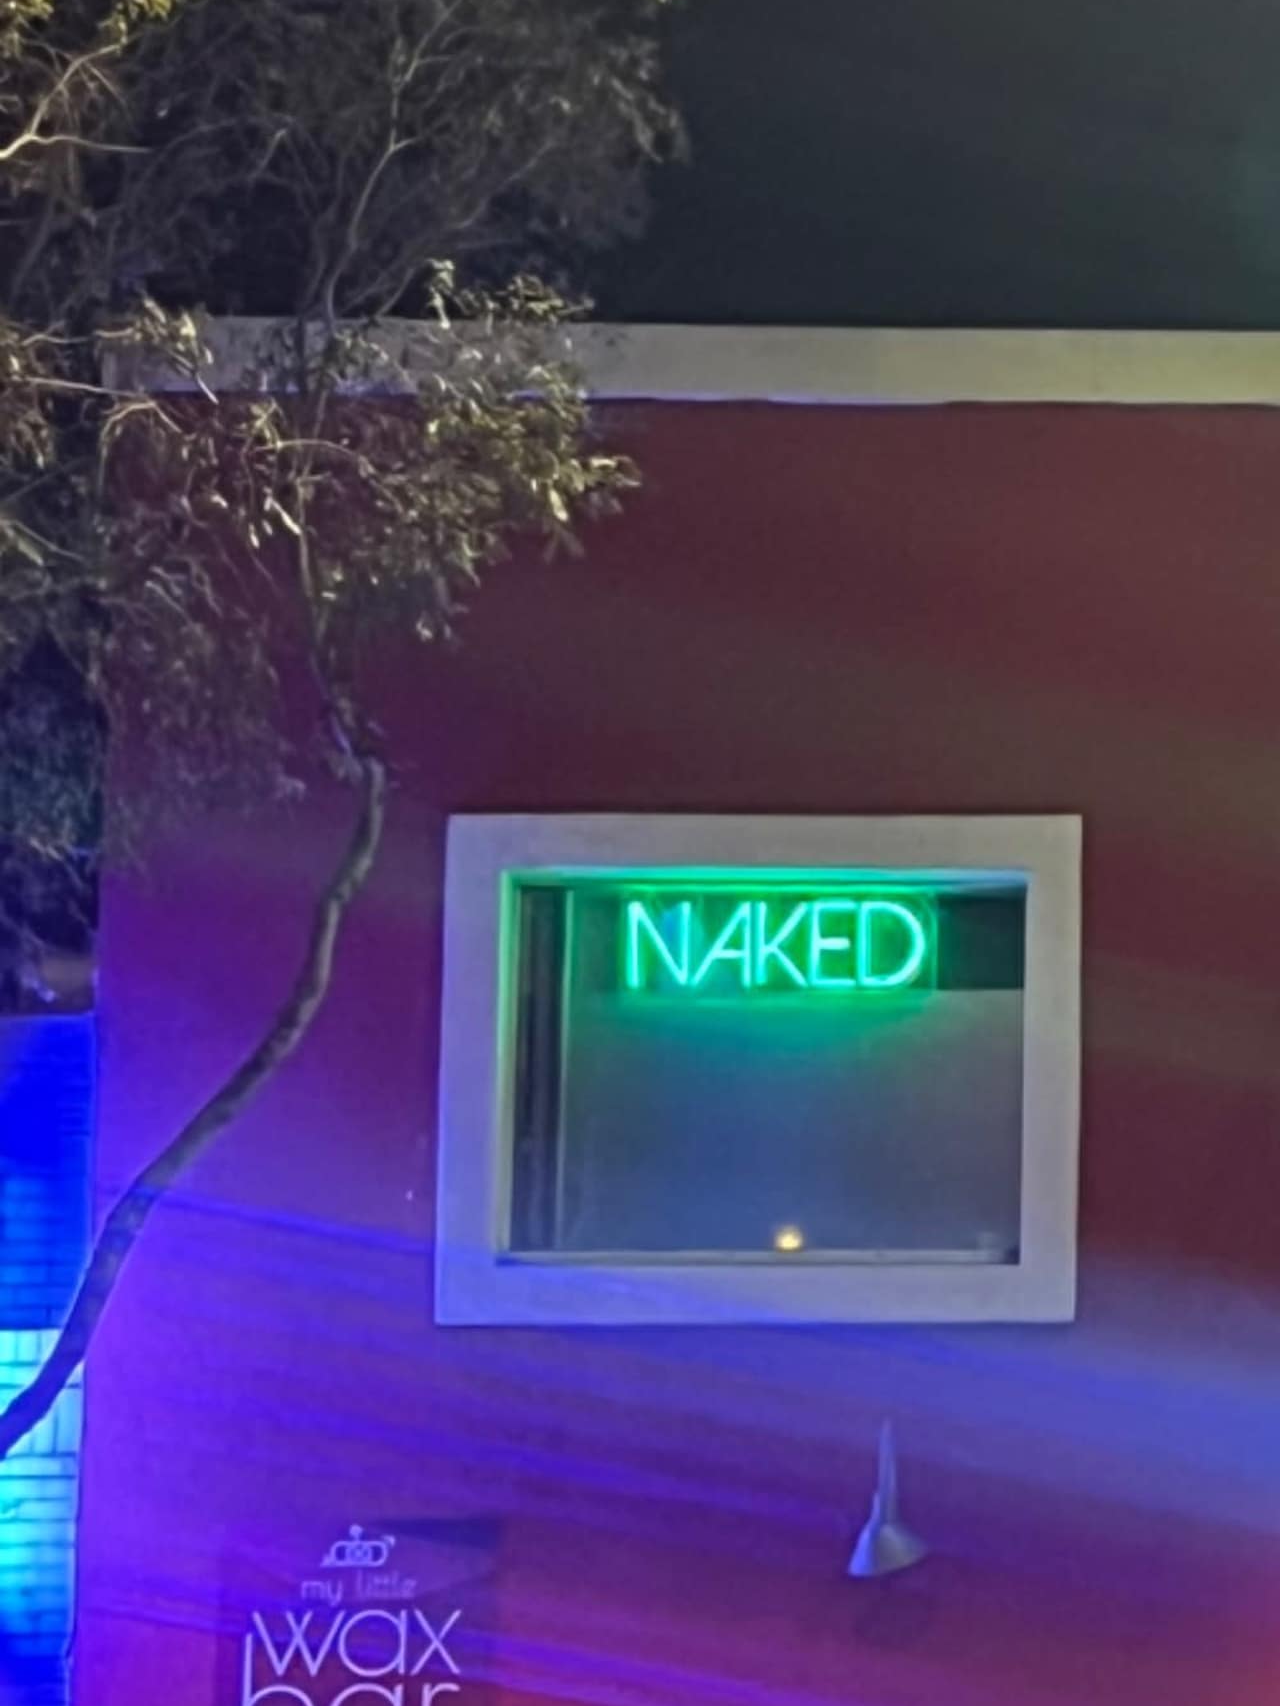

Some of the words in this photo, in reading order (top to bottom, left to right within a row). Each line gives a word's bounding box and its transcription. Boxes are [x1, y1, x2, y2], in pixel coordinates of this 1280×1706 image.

[626, 900, 926, 987] NAKED
[301, 1579, 343, 1607] my
[252, 1608, 462, 1676] wax
